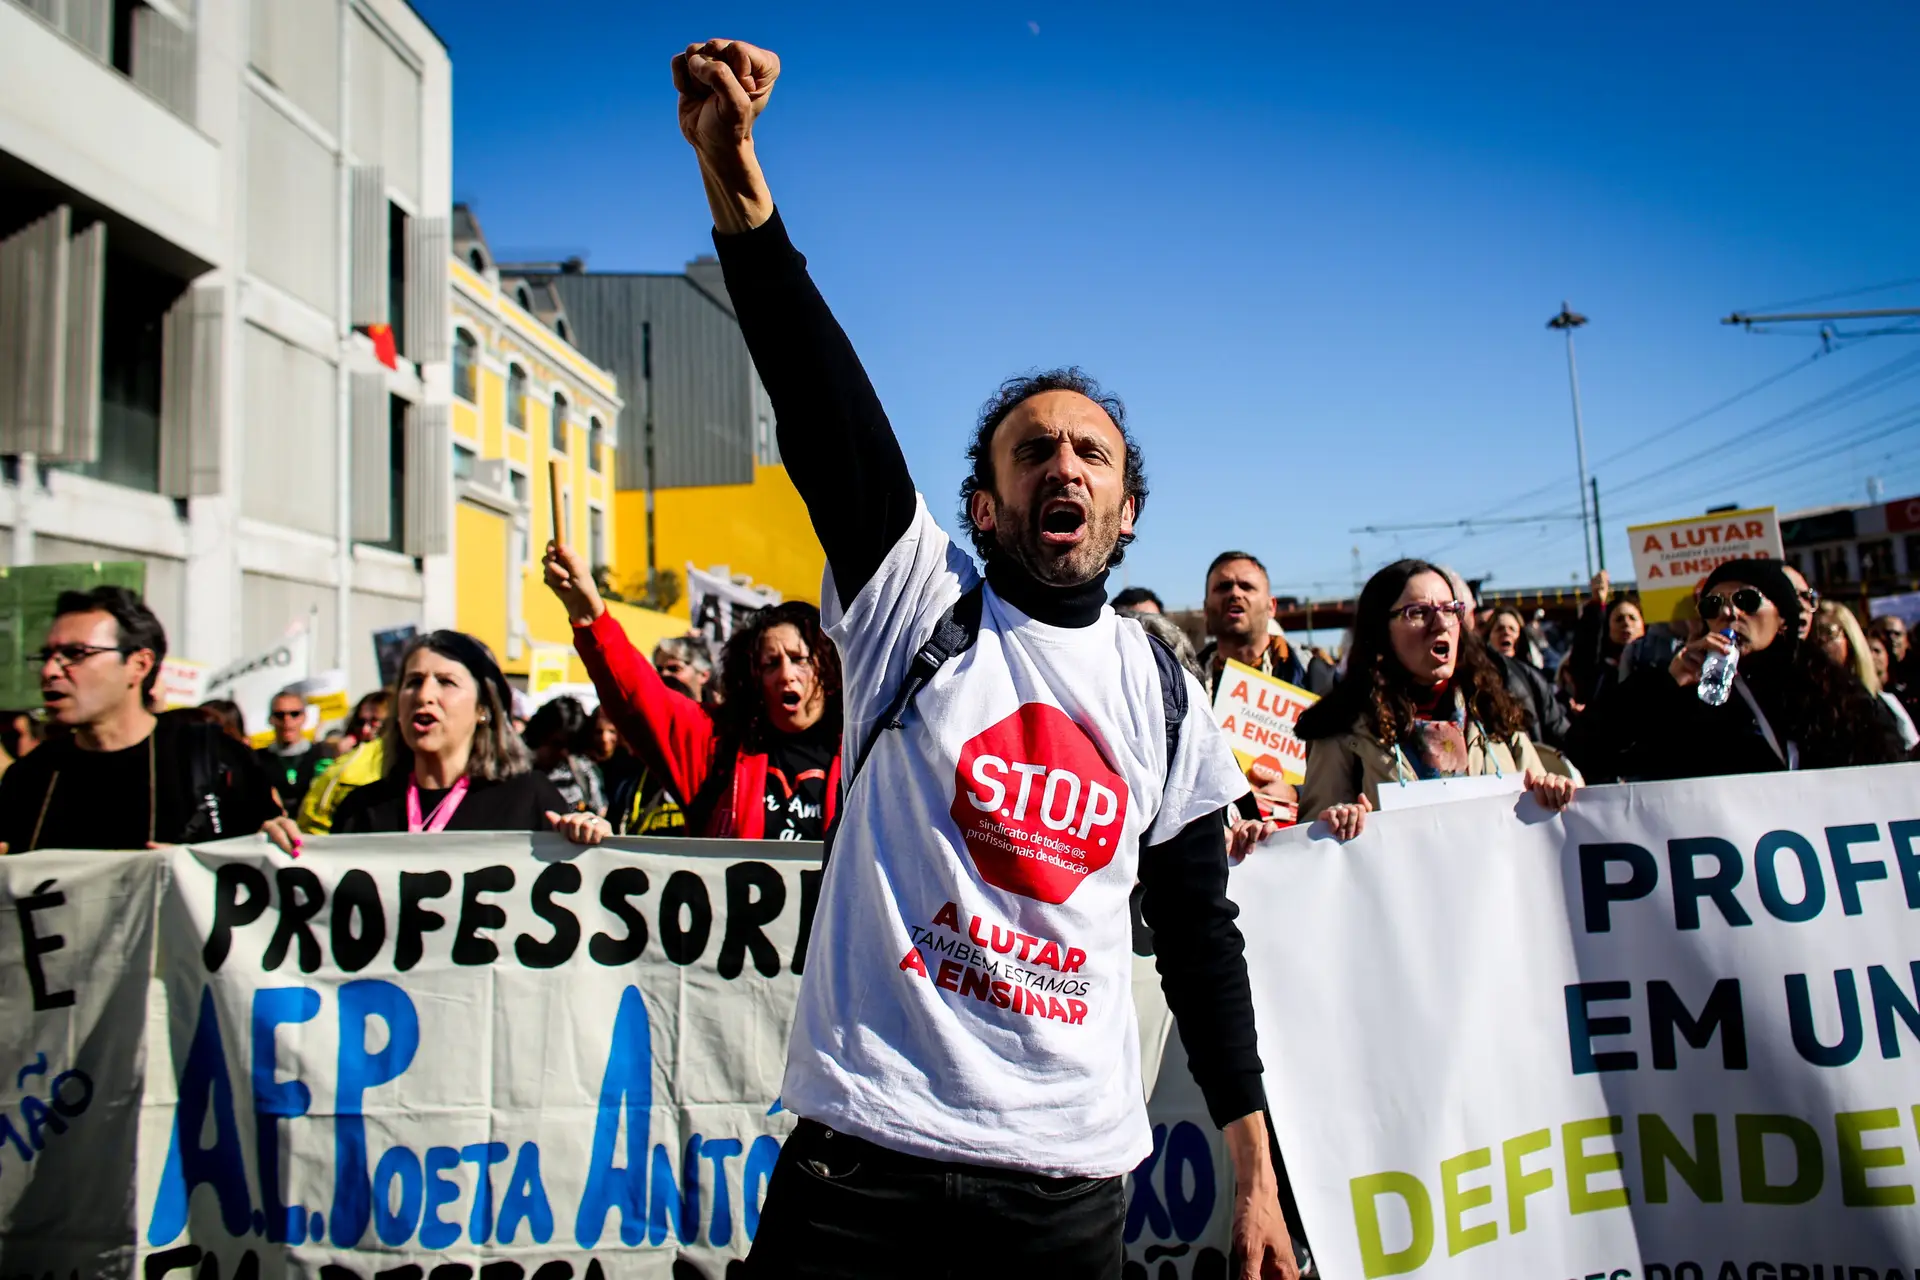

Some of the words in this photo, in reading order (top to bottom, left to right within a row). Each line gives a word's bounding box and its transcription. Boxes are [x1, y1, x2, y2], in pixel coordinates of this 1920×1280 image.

[1642, 534, 1664, 554] A
[1670, 520, 1764, 549] LUTAR
[1648, 562, 1664, 579] A
[1221, 715, 1236, 733] A
[1230, 680, 1249, 704] A
[1257, 688, 1307, 723] LUT
[966, 754, 1118, 847] S.T.O.P.
[965, 827, 1035, 859] profissionais
[1036, 849, 1047, 862] de
[1047, 853, 1089, 875] educação
[978, 818, 1028, 842] sindicato
[1030, 832, 1043, 846] de
[1044, 837, 1071, 854] tod@s
[1071, 848, 1087, 860] @s
[16, 878, 76, 1012] É
[911, 926, 998, 976] TAMBÉM
[1004, 964, 1090, 996] ESTAMOS
[932, 901, 960, 933] A
[968, 915, 1087, 973] LUTAR
[899, 946, 927, 978] A
[935, 958, 1089, 1025] ENSINAR
[1564, 978, 1748, 1075] EM
[1349, 1104, 1920, 1279] DEFENDE
